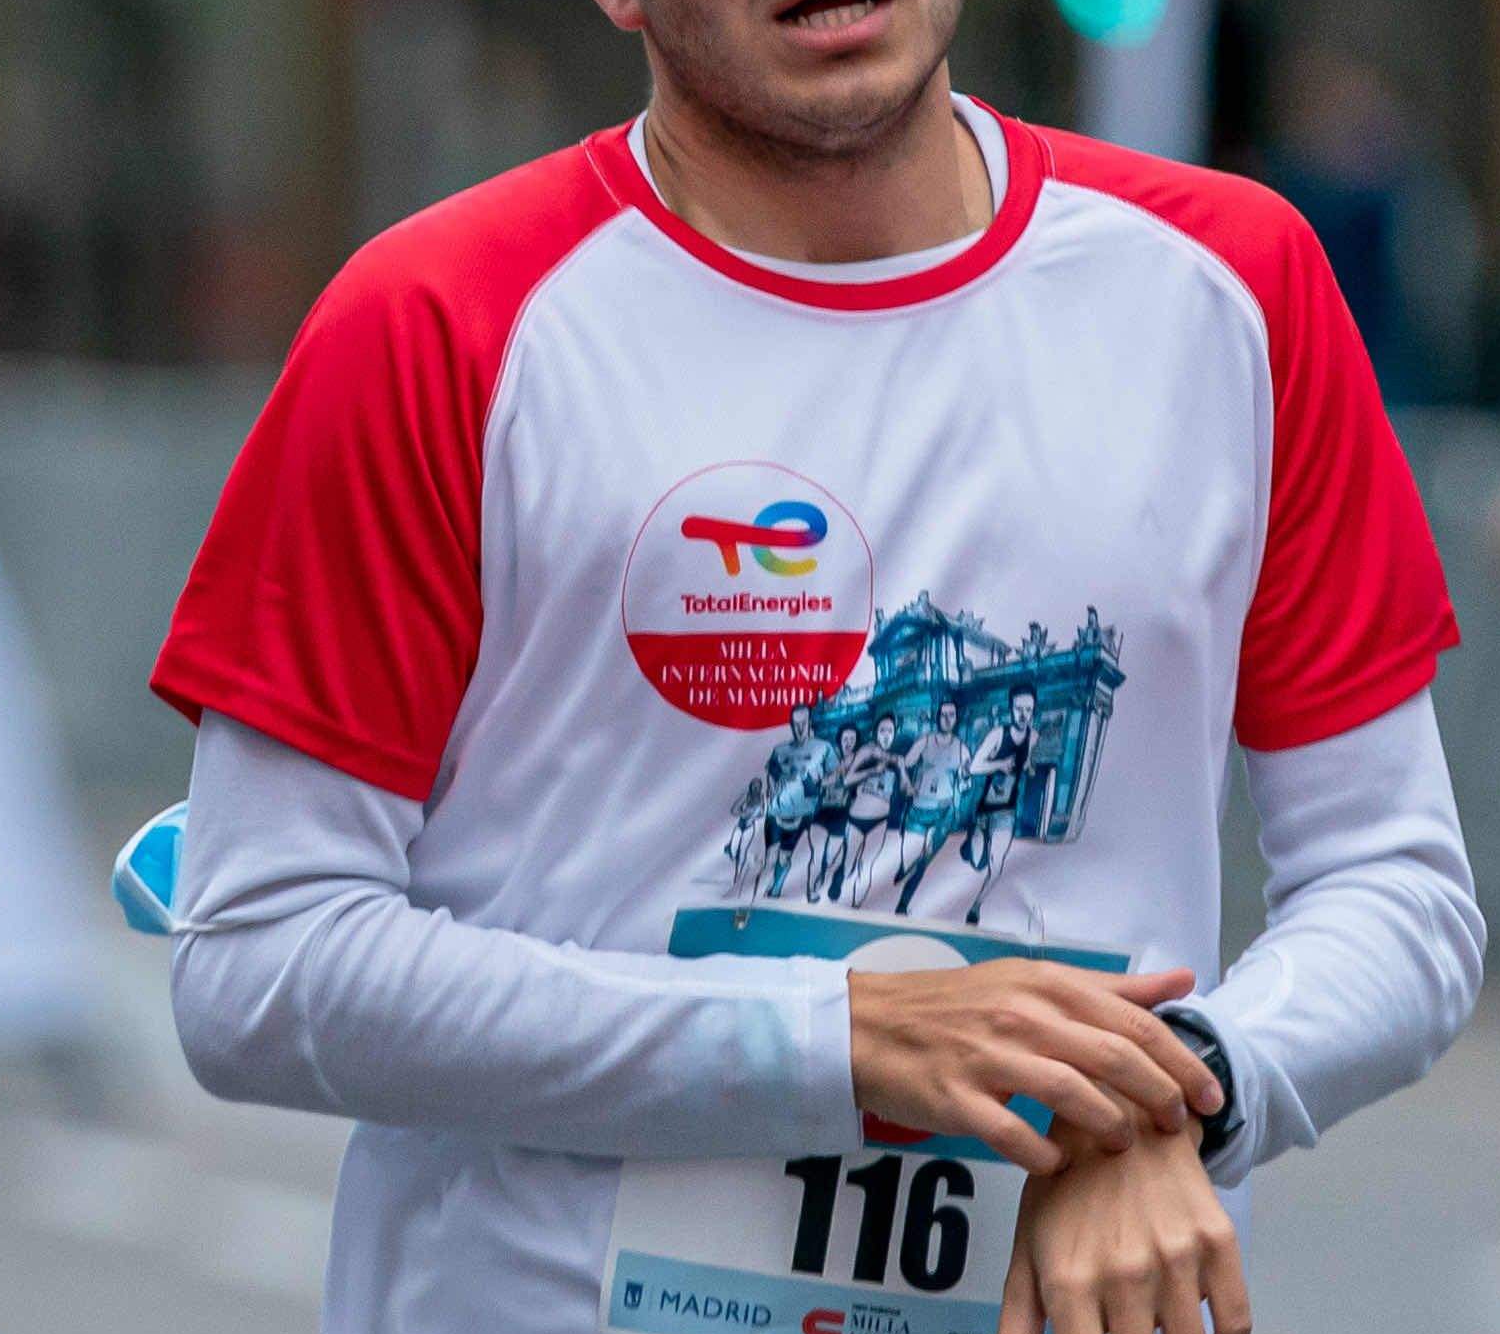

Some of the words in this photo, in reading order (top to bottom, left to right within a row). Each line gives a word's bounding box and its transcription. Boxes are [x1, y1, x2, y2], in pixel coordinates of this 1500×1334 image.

[681, 591, 833, 618] TotalEnergies
[719, 639, 789, 660] MILLA
[687, 686, 720, 707] DE
[727, 686, 814, 707] MADRID
[785, 1153, 975, 1292] 116
[660, 1288, 772, 1328] MADRID
